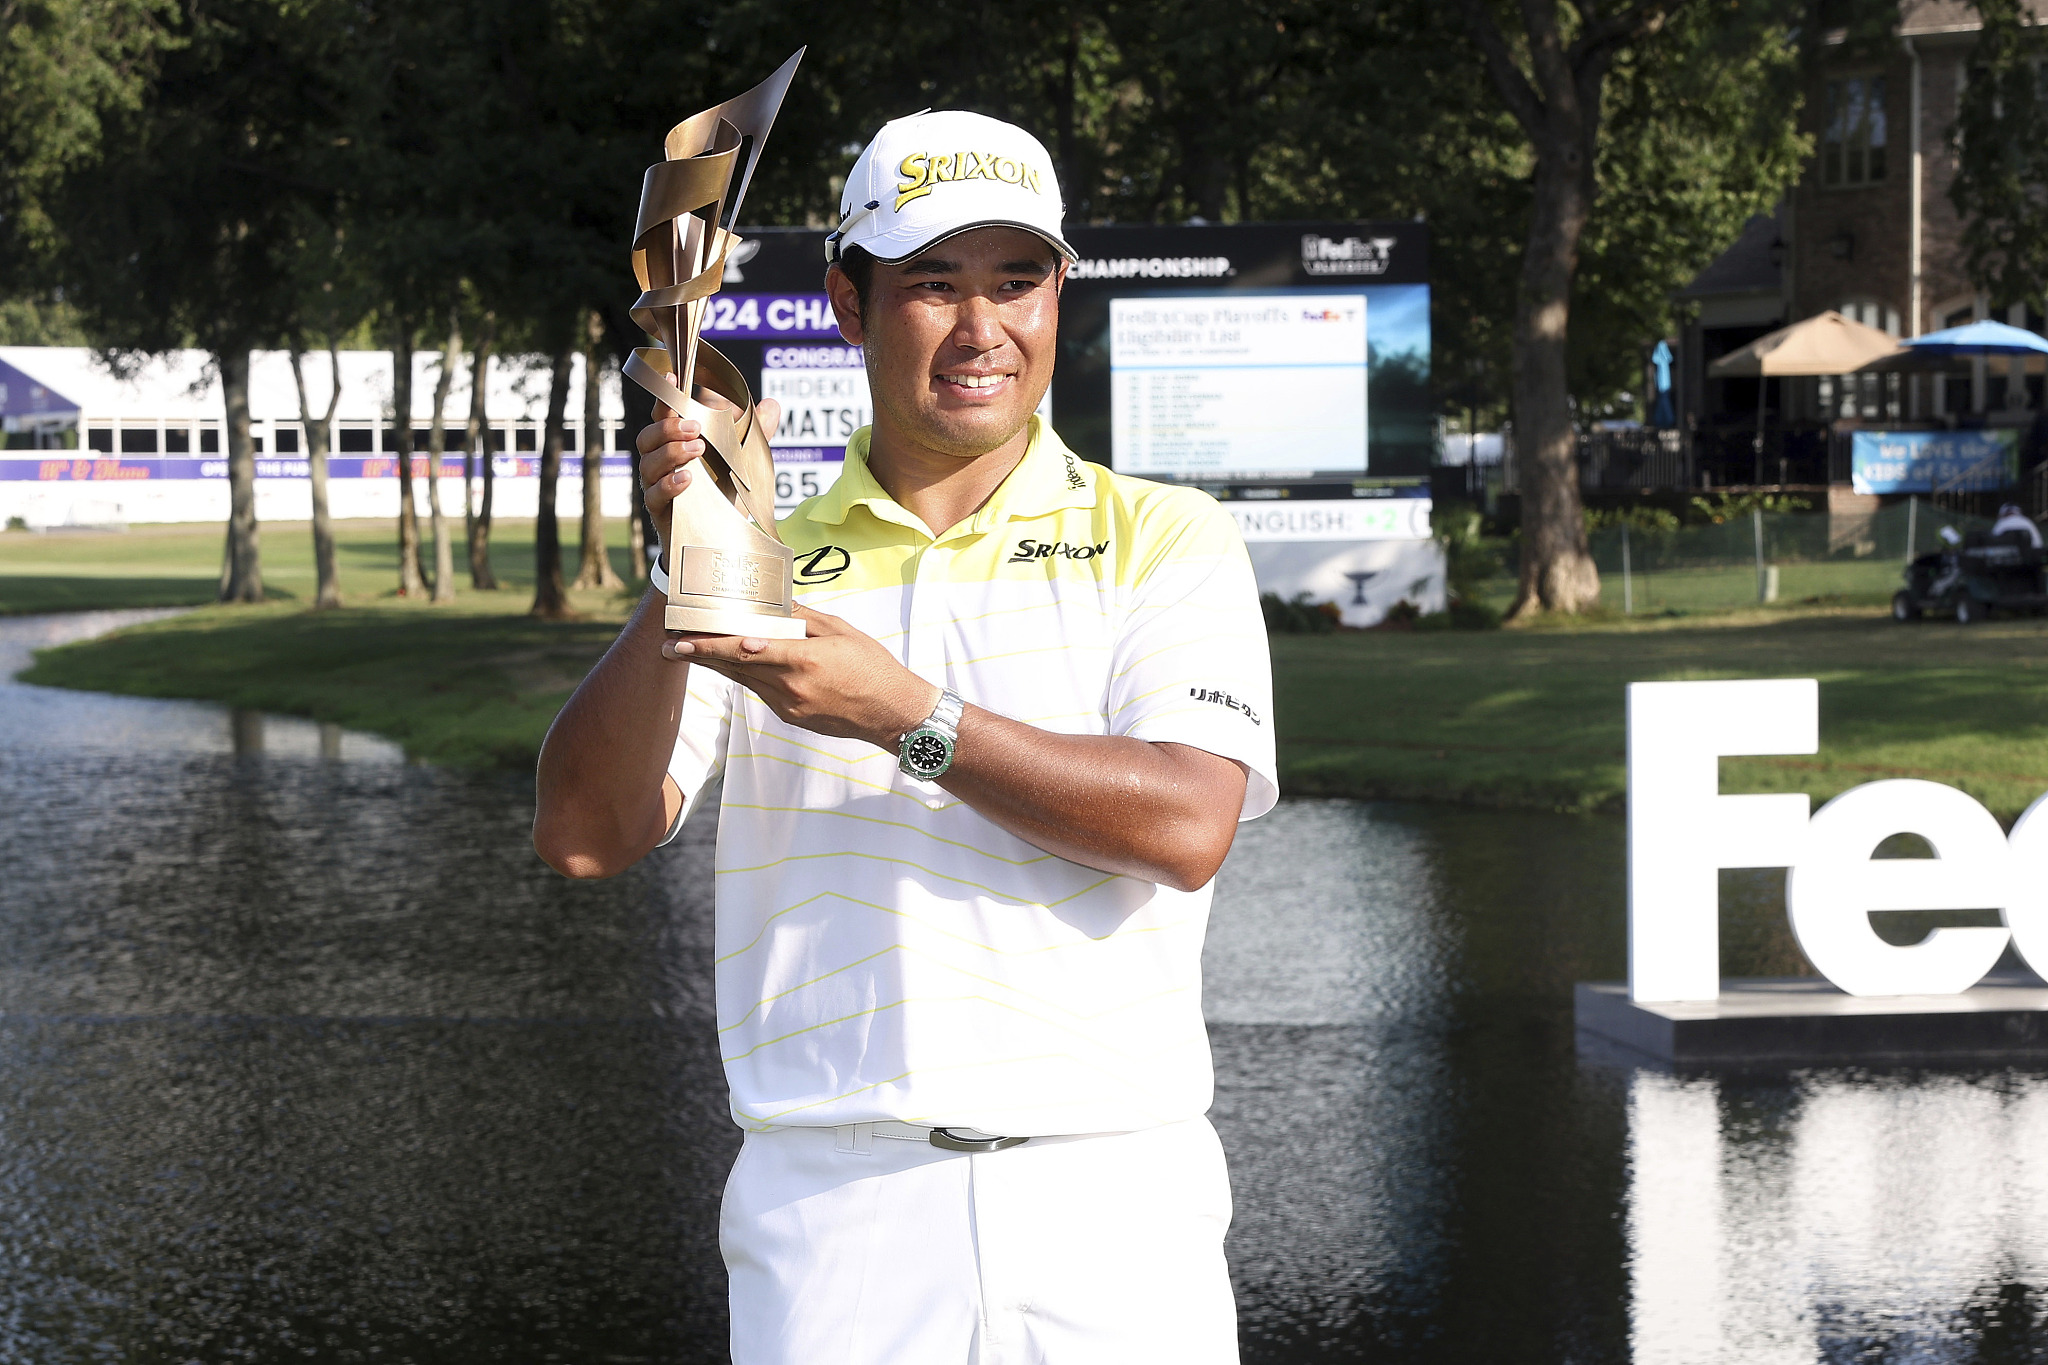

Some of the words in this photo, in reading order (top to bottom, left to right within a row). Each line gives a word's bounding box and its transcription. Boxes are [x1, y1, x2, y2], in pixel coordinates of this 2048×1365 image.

[894, 151, 1041, 212] SRIXON
[766, 347, 865, 369] CONGRA
[769, 377, 855, 398] HIDEKI
[200, 460, 229, 478] OPE
[1063, 453, 1087, 492] indeed
[776, 472, 819, 498] 65
[1234, 510, 1353, 533] NGLISH:
[1364, 508, 1398, 531] +2
[1008, 539, 1110, 563] SRIXON
[711, 586, 759, 597] CHAMNSHIP
[1189, 688, 1261, 726] リポビタン
[1626, 678, 2048, 1002] Fe
